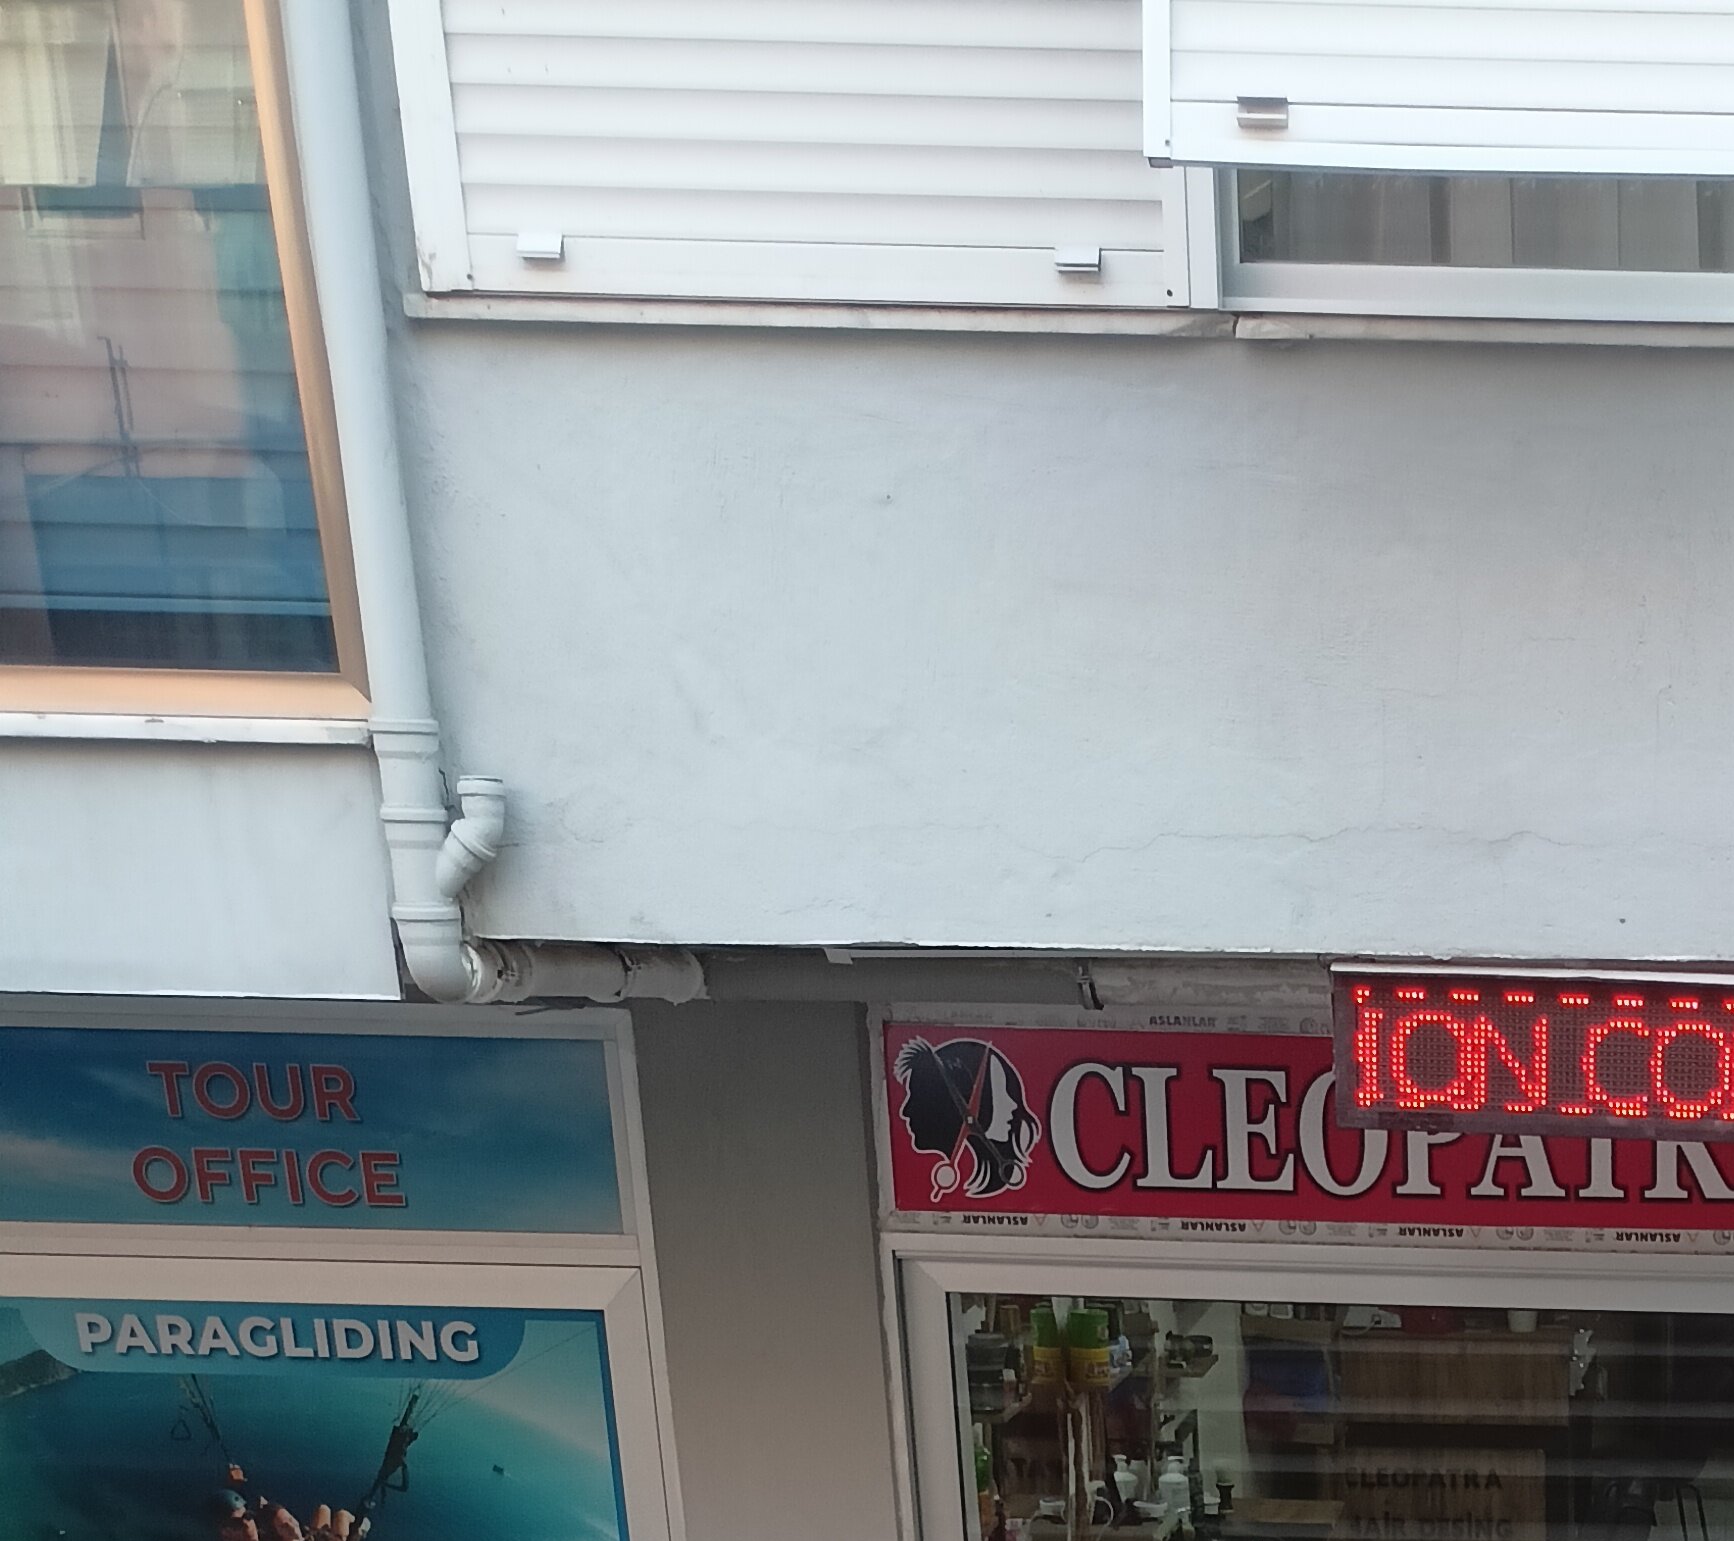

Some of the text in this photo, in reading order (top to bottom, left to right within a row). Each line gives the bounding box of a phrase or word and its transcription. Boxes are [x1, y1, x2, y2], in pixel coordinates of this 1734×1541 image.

[1149, 1015, 1217, 1028] ASLANLAR
[148, 1060, 361, 1123] TOUR
[131, 1147, 407, 1208] OFFICE
[961, 1214, 1028, 1226] ASLANLAR
[1180, 1220, 1247, 1233] ASLANLAR
[1398, 1226, 1465, 1239] ASLANLAR
[1615, 1230, 1682, 1243] ASLANLAR
[76, 1313, 481, 1363] PARAGLIDING
